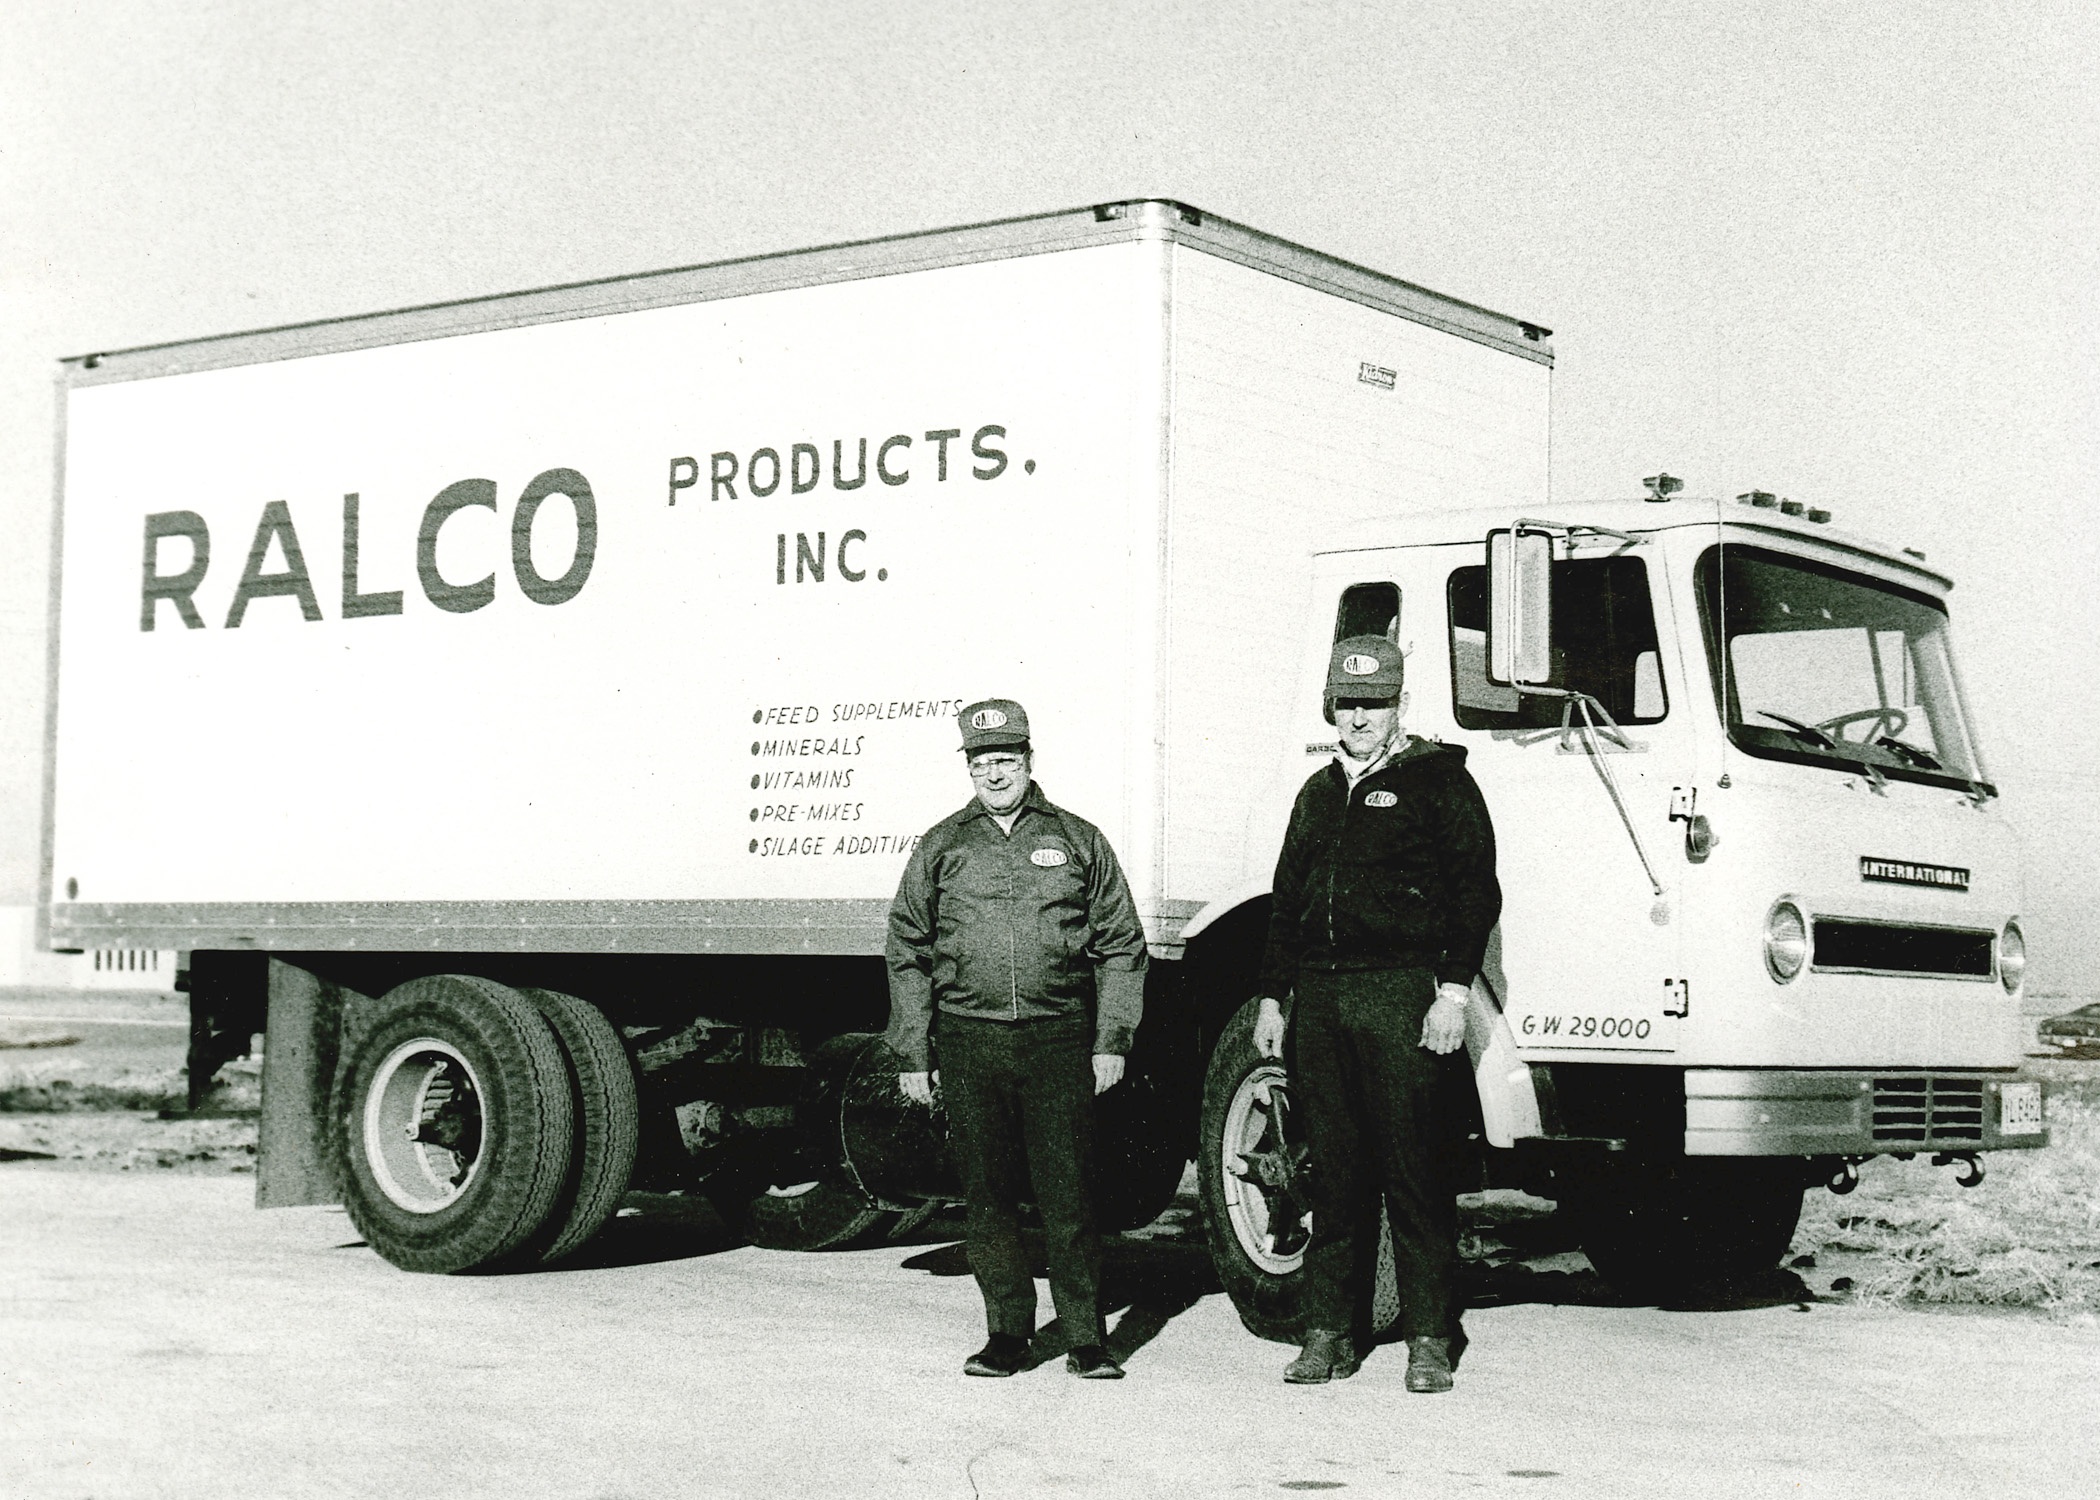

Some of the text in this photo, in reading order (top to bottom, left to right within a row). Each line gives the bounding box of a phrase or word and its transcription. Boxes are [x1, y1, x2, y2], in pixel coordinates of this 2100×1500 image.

[140, 467, 598, 632] RALCO
[777, 529, 888, 584] INC.
[765, 699, 962, 725] FEED SUPPLEMENTS
[763, 736, 865, 757] MINERALS
[764, 769, 855, 790] VITAMINS
[762, 803, 864, 821] PRE-MIXES
[761, 837, 826, 856] SILAGE
[1862, 861, 1968, 886] INTERNATIONAL
